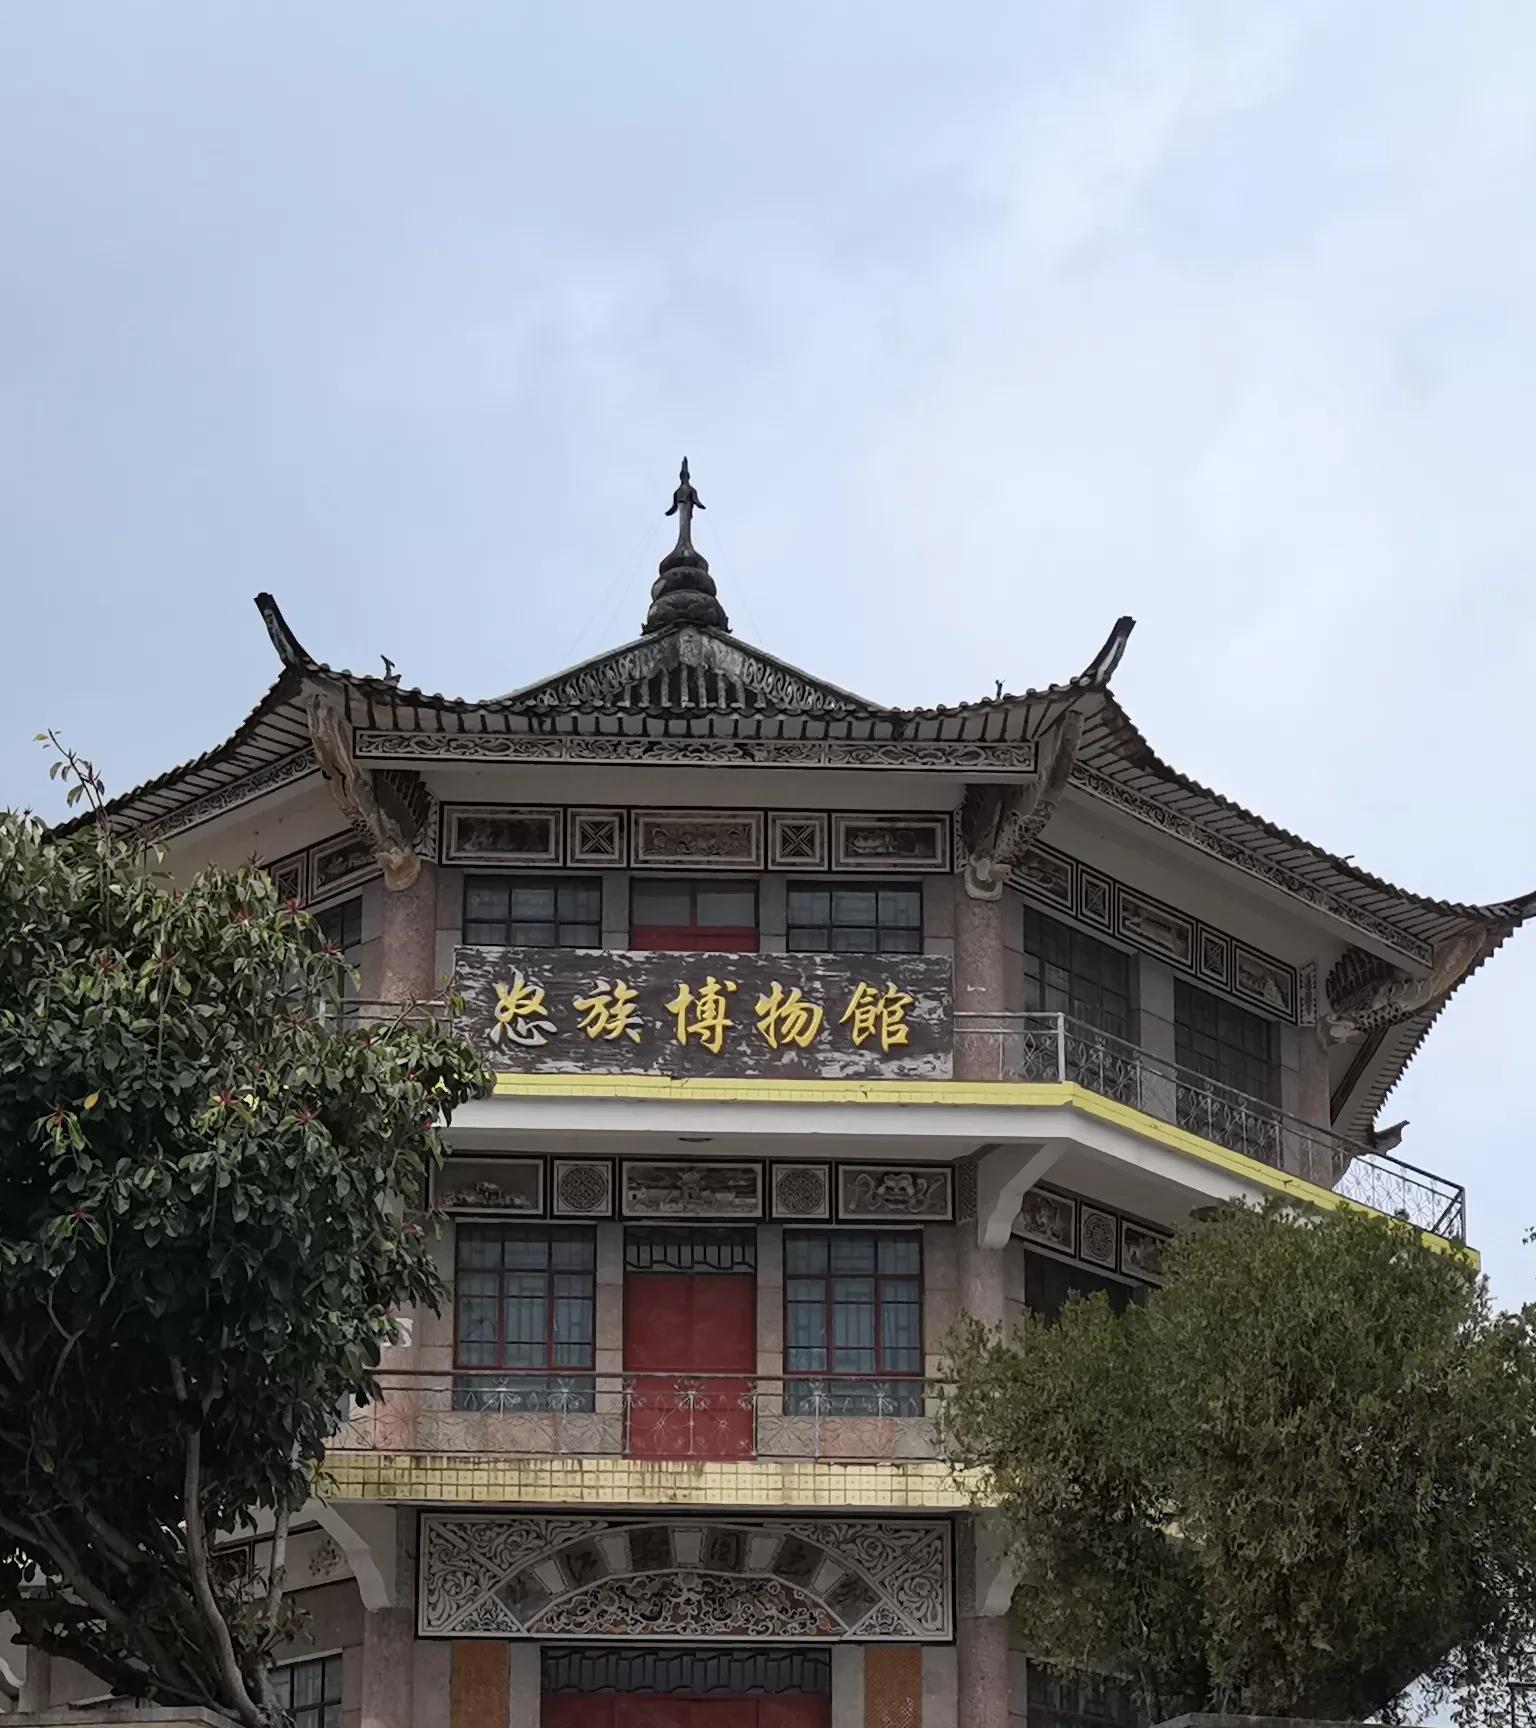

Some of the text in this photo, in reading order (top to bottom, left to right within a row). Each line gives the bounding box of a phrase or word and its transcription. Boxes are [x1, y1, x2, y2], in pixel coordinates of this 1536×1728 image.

[490, 971, 915, 1054] 怒族博物館
